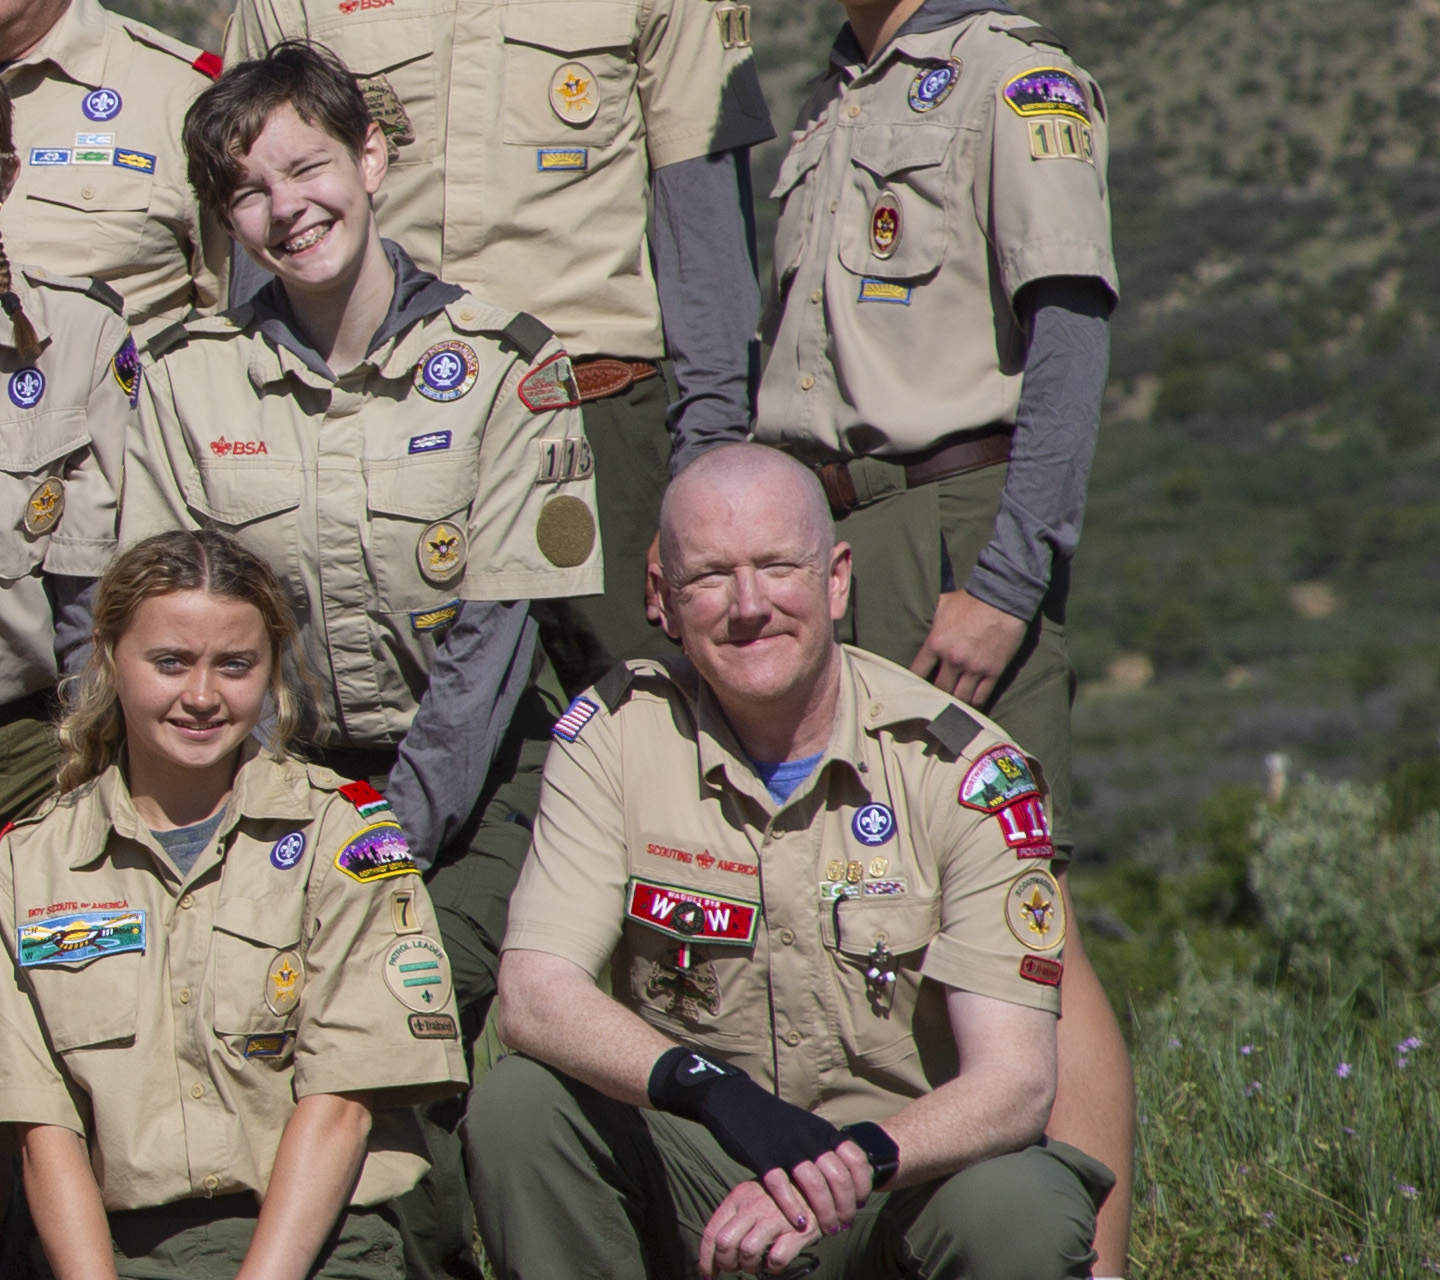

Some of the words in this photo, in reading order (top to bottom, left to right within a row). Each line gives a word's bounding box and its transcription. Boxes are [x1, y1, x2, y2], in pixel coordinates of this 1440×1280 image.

[232, 441, 269, 455] BSA
[646, 843, 693, 864] SCOUTING
[667, 891, 702, 904] WAGULI
[388, 941, 412, 967] PATROL
[412, 940, 444, 960] LEADER
